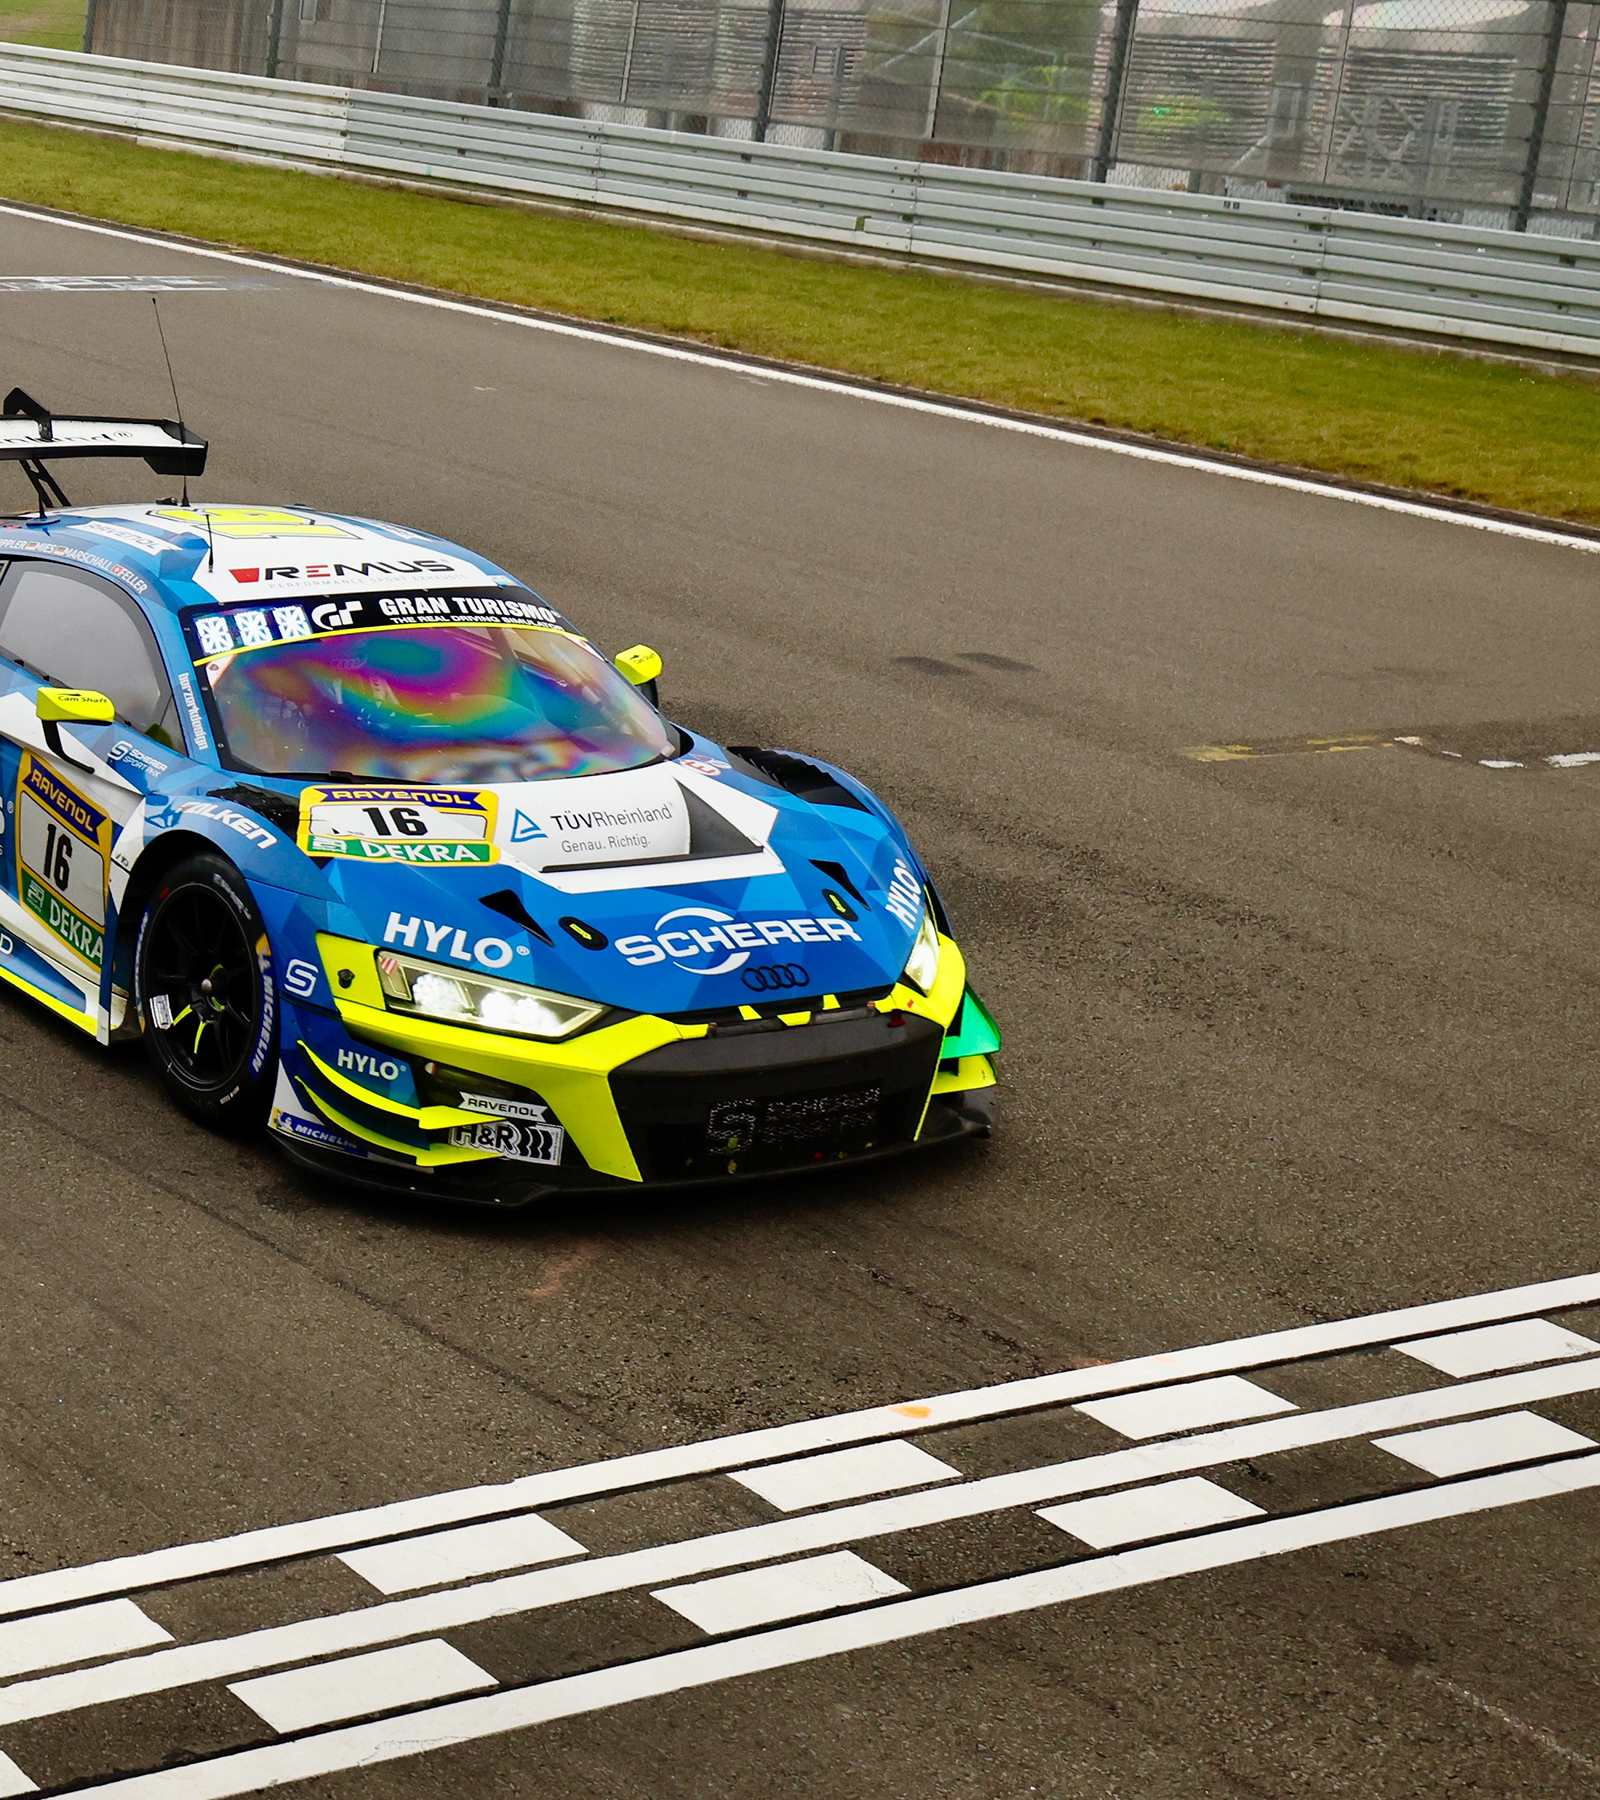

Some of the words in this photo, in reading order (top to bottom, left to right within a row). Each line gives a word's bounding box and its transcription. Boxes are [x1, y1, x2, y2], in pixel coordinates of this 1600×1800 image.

[84, 523, 162, 550] RAVENOL
[35, 542, 57, 554] MIES
[63, 547, 112, 572] MARSCHALL
[120, 569, 148, 594] FELLER
[265, 560, 456, 580] REMUS
[369, 575, 406, 585] SPORT
[379, 596, 450, 616] GRAN
[390, 616, 414, 624] THE
[417, 614, 450, 623] REAL
[452, 614, 501, 624] DRIVING
[503, 615, 566, 632] SIMULATOR
[81, 695, 108, 703] Shaft
[122, 756, 147, 771] SPORT
[129, 749, 168, 772] SCHERER
[31, 768, 94, 832] RAVENOL
[331, 790, 472, 805] RAVENOL
[175, 802, 278, 849] FALKEN
[362, 807, 428, 836] 16
[359, 840, 482, 862] DEKRA
[561, 839, 606, 853] Genau.
[609, 834, 651, 849] Richtig.
[43, 823, 72, 892] 16
[49, 898, 104, 965] DEKRA
[615, 918, 863, 966] SCHERER
[252, 974, 274, 1073] MICHELIN
[468, 1098, 538, 1117] RAVENOL
[455, 1122, 514, 1151] H&R
